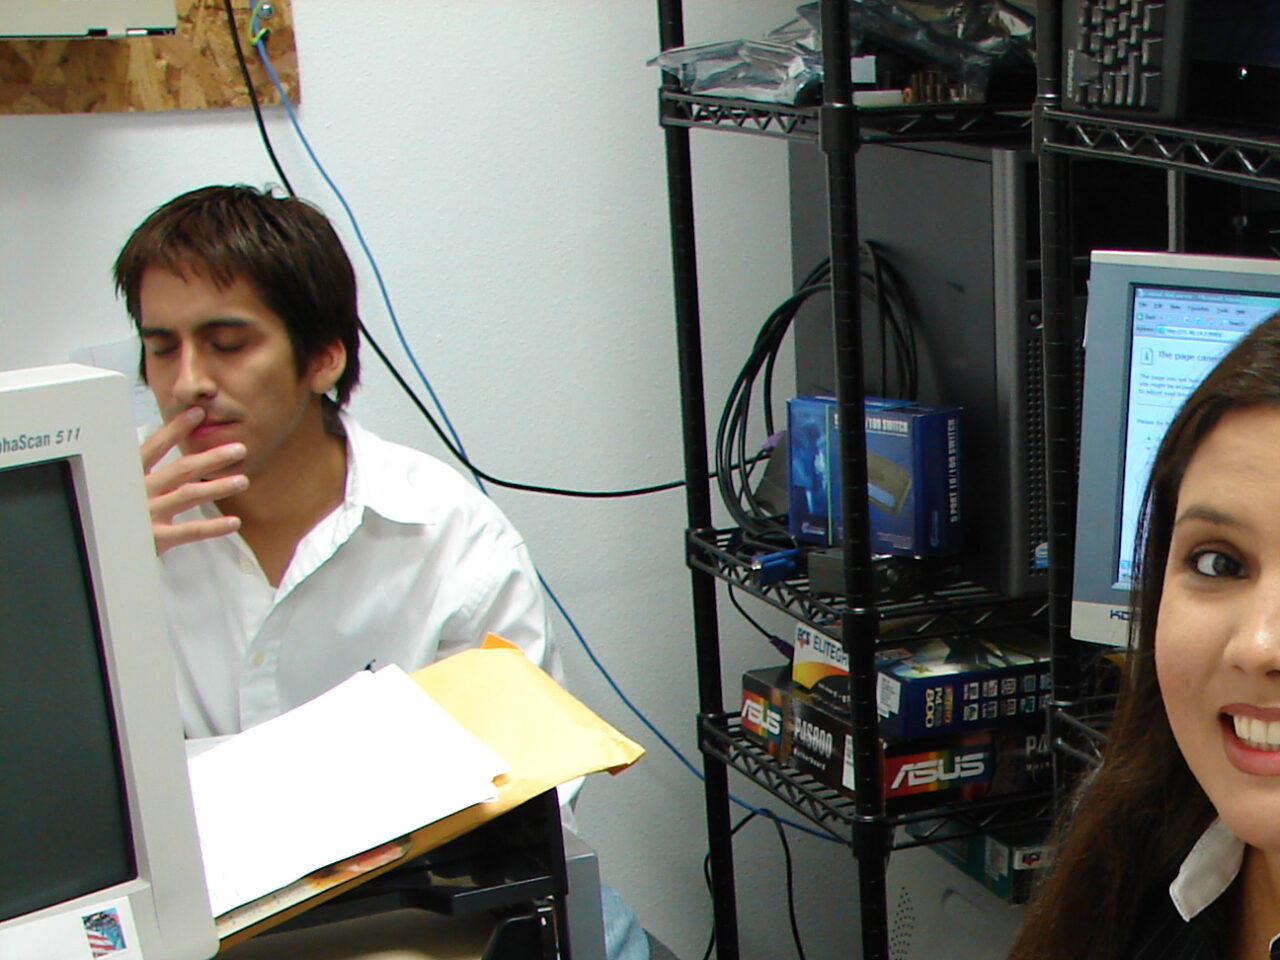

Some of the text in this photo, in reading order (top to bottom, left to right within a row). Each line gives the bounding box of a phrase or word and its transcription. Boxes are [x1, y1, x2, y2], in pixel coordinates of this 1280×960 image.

[1175, 352, 1196, 362] page
[55, 427, 81, 445] 511
[883, 419, 909, 433] SWITCH
[947, 419, 956, 454] SWITCH
[948, 456, 957, 488] 10/100
[949, 492, 959, 514] PORT
[797, 626, 811, 646] ECS
[741, 698, 783, 736] ASUS
[925, 688, 935, 728] 800
[793, 716, 834, 759] P4S800
[890, 753, 986, 790] ASUS
